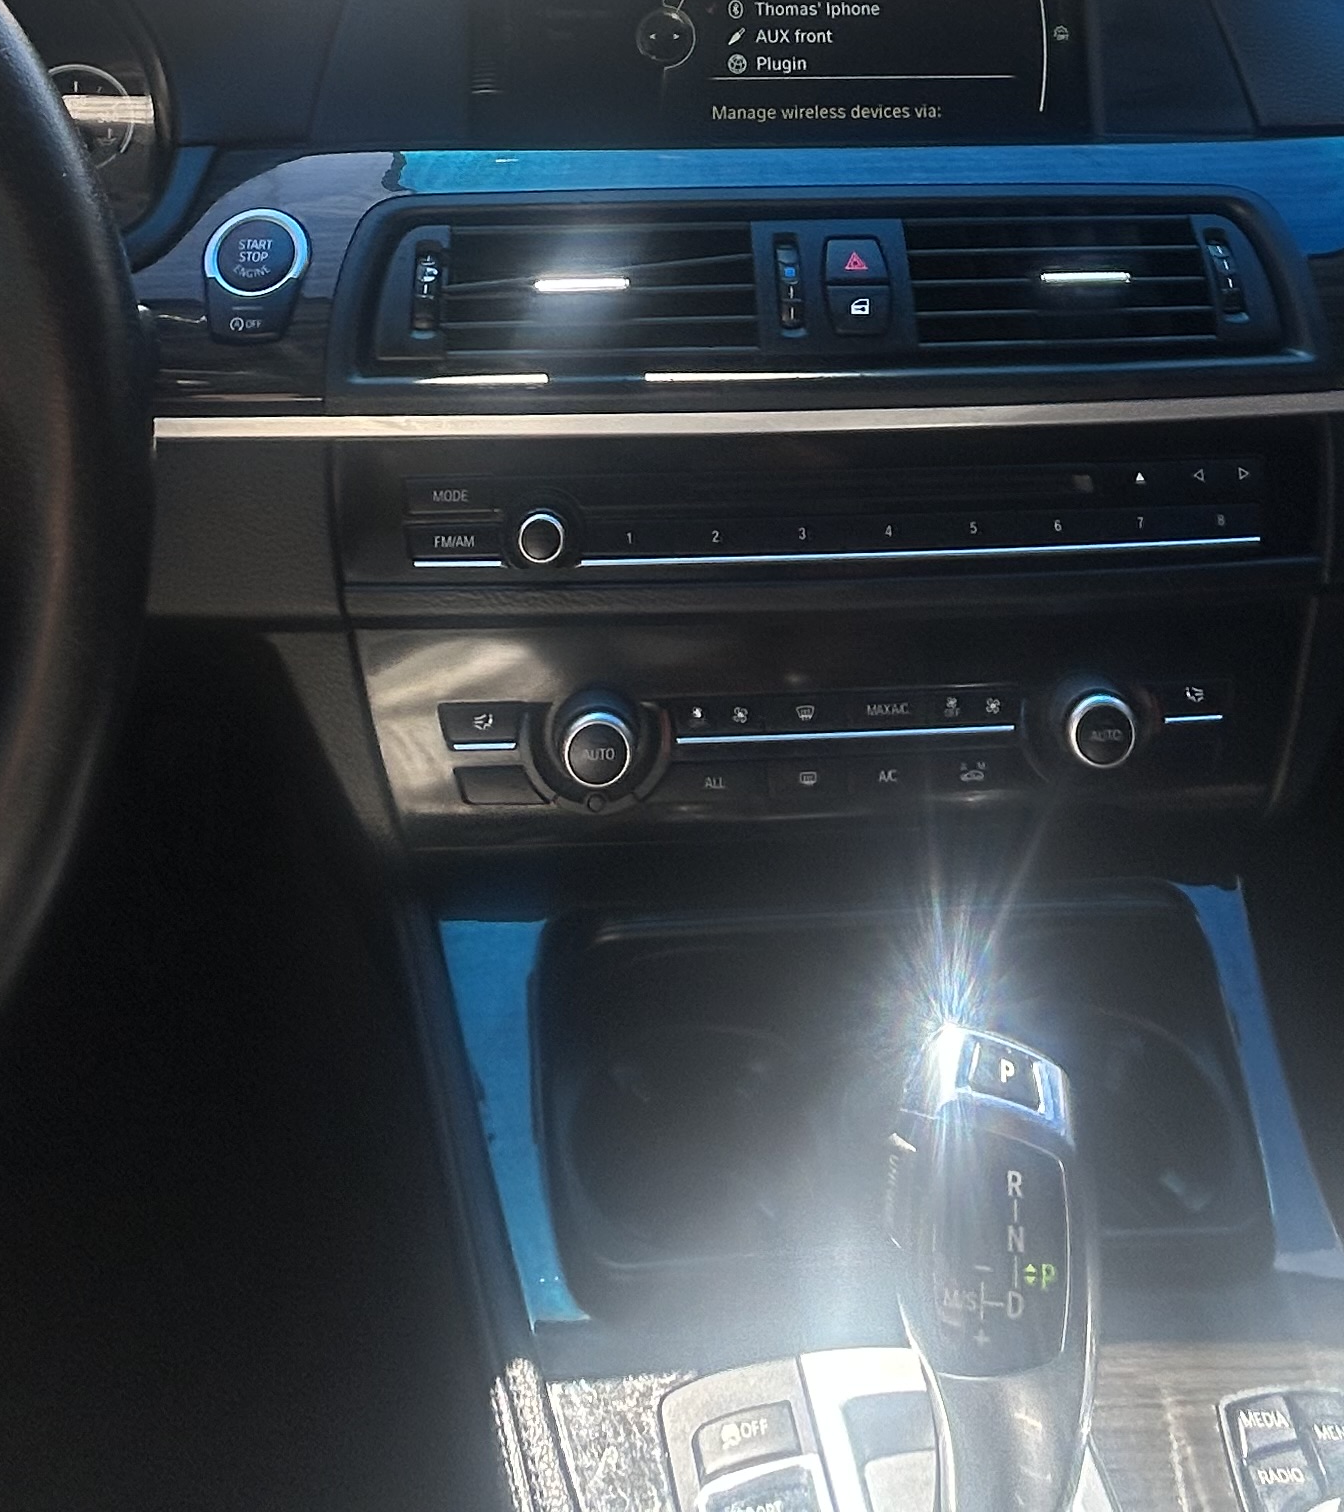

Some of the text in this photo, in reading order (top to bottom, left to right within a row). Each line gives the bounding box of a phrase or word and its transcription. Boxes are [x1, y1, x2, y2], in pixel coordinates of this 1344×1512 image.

[755, 0, 822, 17] Thomas'
[755, 29, 834, 44] AUX front
[756, 56, 808, 75] Plugin
[711, 103, 943, 123] Manage wireless devices via:
[238, 238, 273, 251] START
[239, 251, 269, 263] STOP
[233, 263, 272, 279] ENGINE
[245, 318, 263, 330] OFF
[432, 489, 469, 504] MODE
[626, 513, 1226, 545] 1 2 3 4 5 6 7 8
[434, 534, 476, 549] FM/AM
[584, 746, 616, 761] AUTO
[705, 775, 726, 789] ALL
[879, 768, 898, 783] A/C
[999, 1058, 1016, 1083] P
[1007, 1169, 1024, 1199] R
[1007, 1225, 1025, 1253] N
[1041, 1263, 1057, 1290] P
[1007, 1290, 1025, 1320] D
[1240, 1408, 1291, 1429] MEDIA
[740, 1418, 769, 1439] OFF
[1258, 1467, 1306, 1485] RADIO
